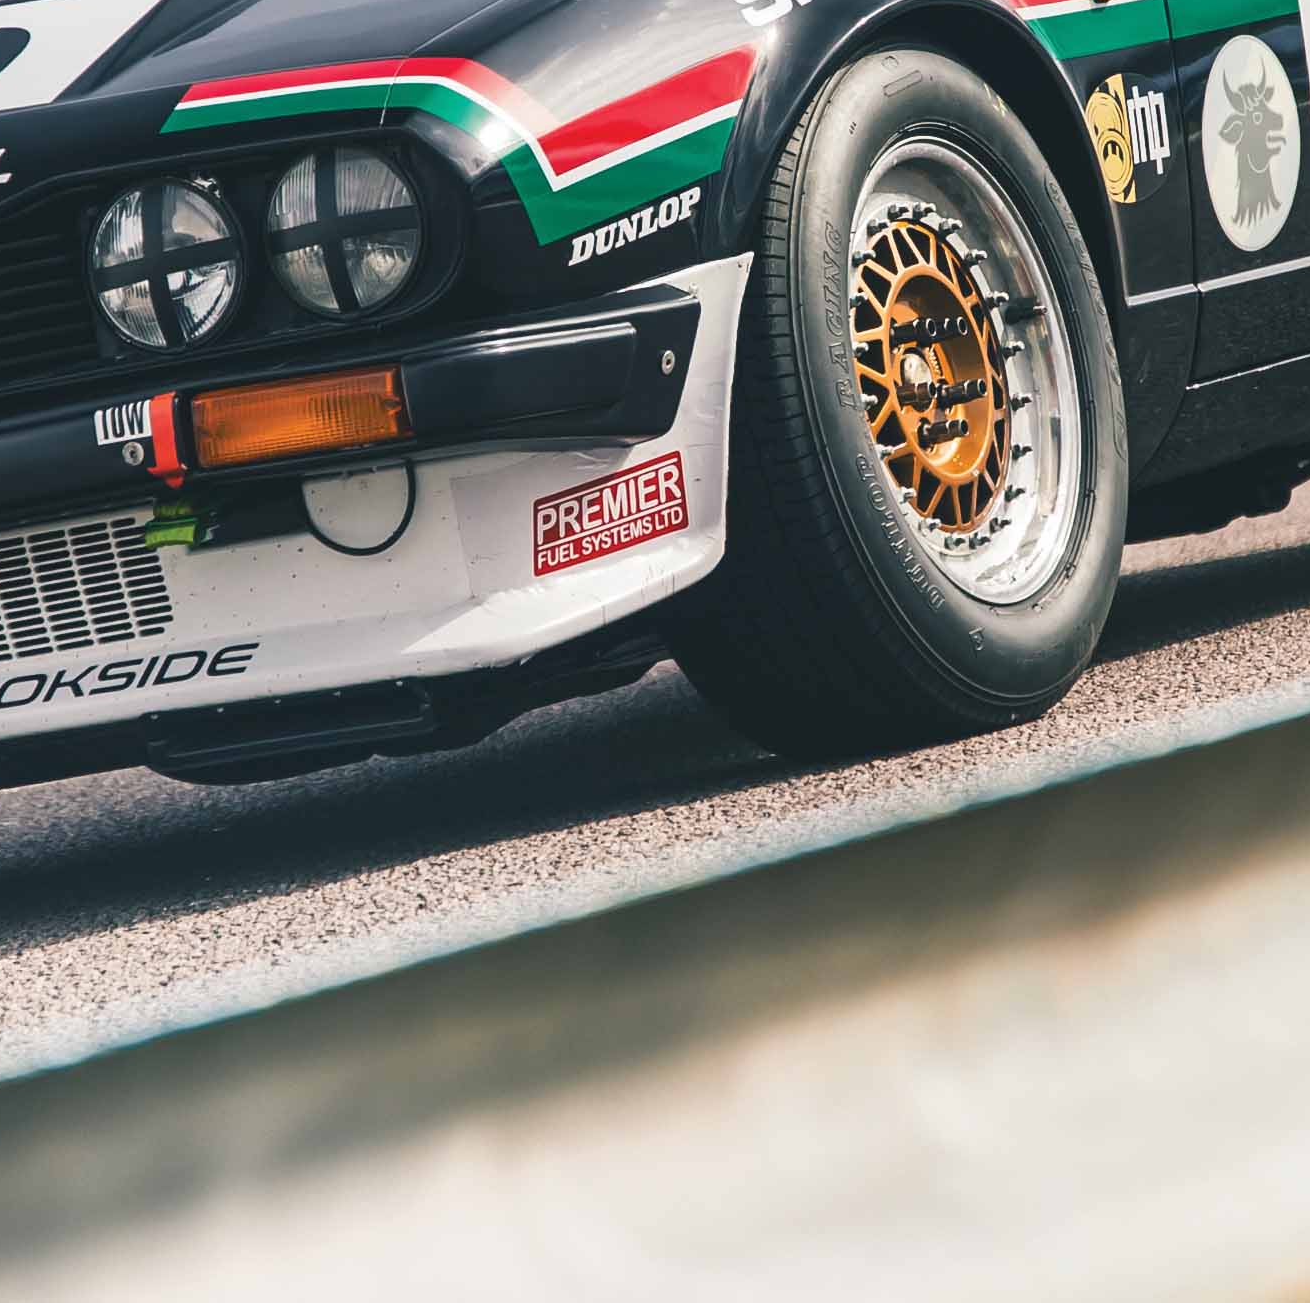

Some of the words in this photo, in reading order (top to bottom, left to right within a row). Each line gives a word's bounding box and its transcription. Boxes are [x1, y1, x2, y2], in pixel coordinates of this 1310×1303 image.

[568, 186, 701, 266] DUNLOP
[824, 221, 860, 410] RACING
[537, 463, 682, 545] PREMIER
[537, 542, 579, 570] FUEL
[581, 516, 653, 556] SYSTEMS
[655, 505, 683, 531] LTD
